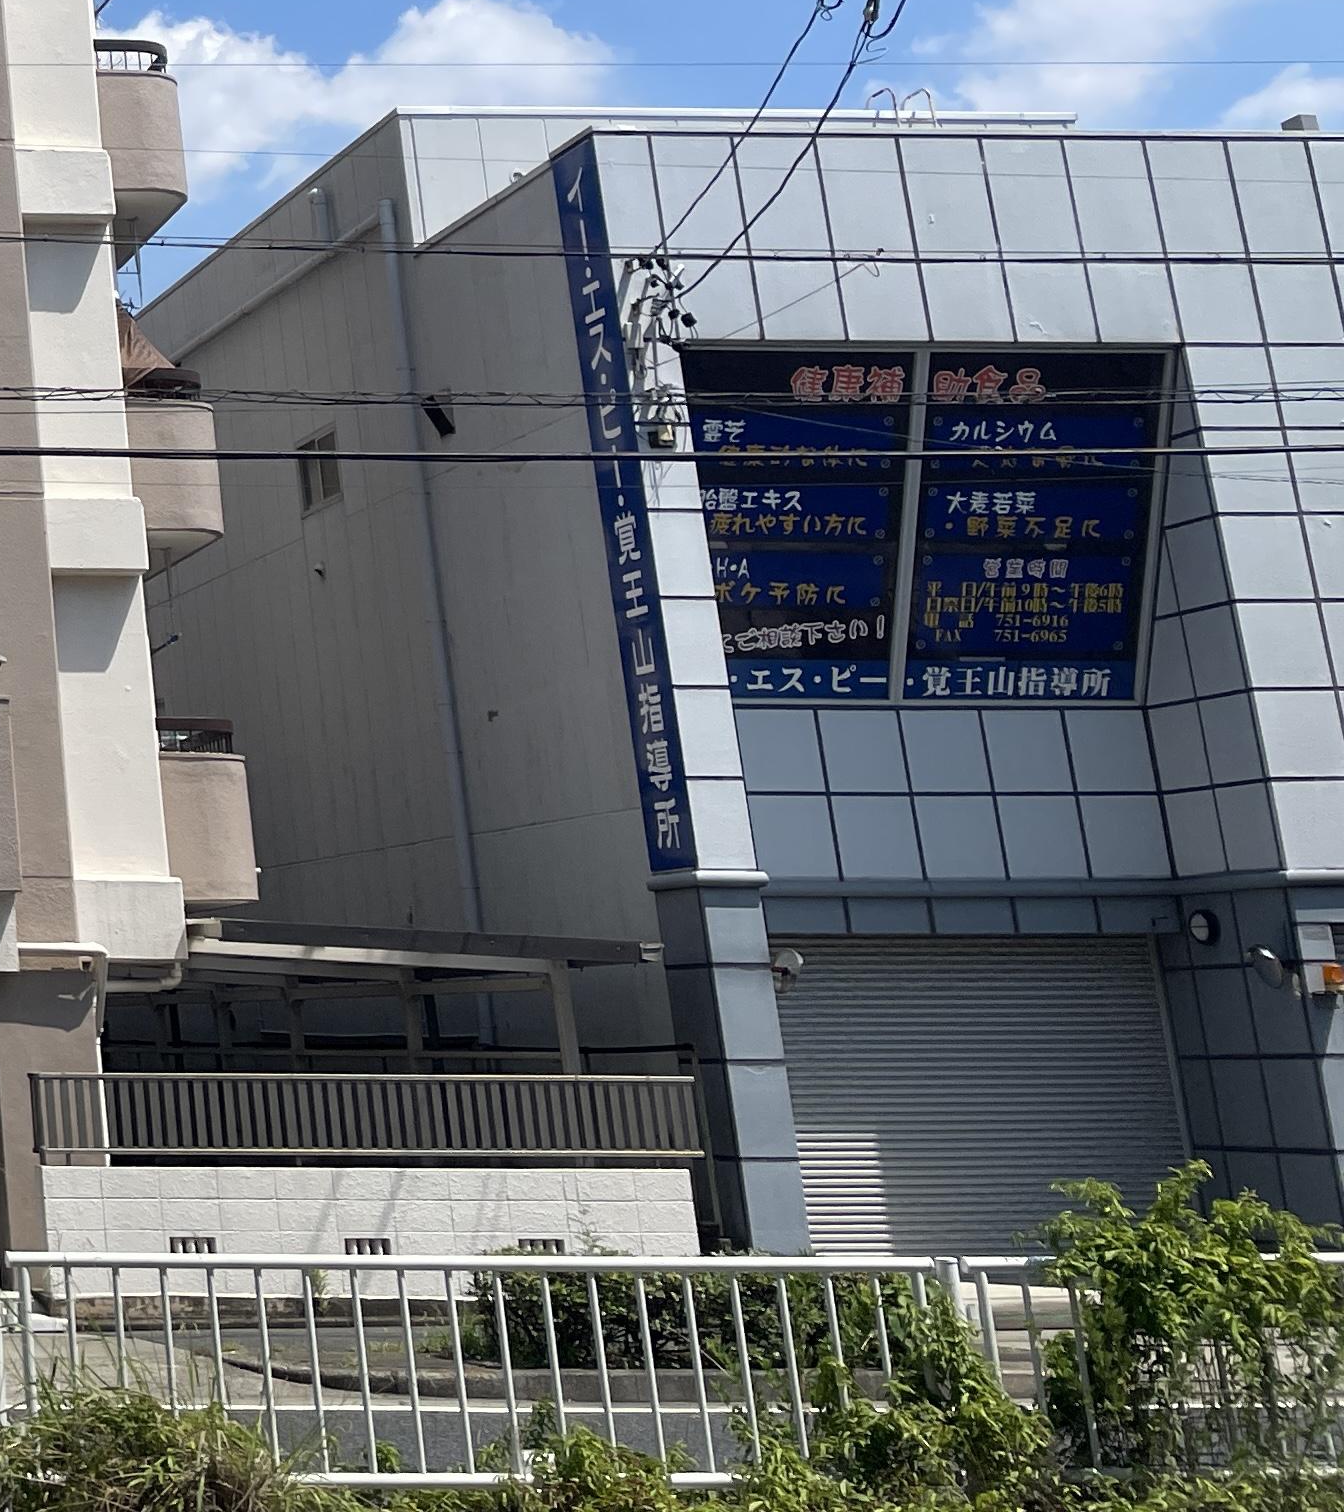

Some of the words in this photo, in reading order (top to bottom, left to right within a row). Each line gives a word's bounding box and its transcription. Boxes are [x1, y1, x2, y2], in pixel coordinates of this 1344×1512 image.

[949, 420, 1057, 443] カルシウム
[946, 491, 1037, 514] 大麦若菜
[982, 557, 1069, 579] 営業時間
[995, 614, 1069, 627] 751-6916
[935, 629, 962, 642] FAX
[994, 629, 1068, 643] 751-6965
